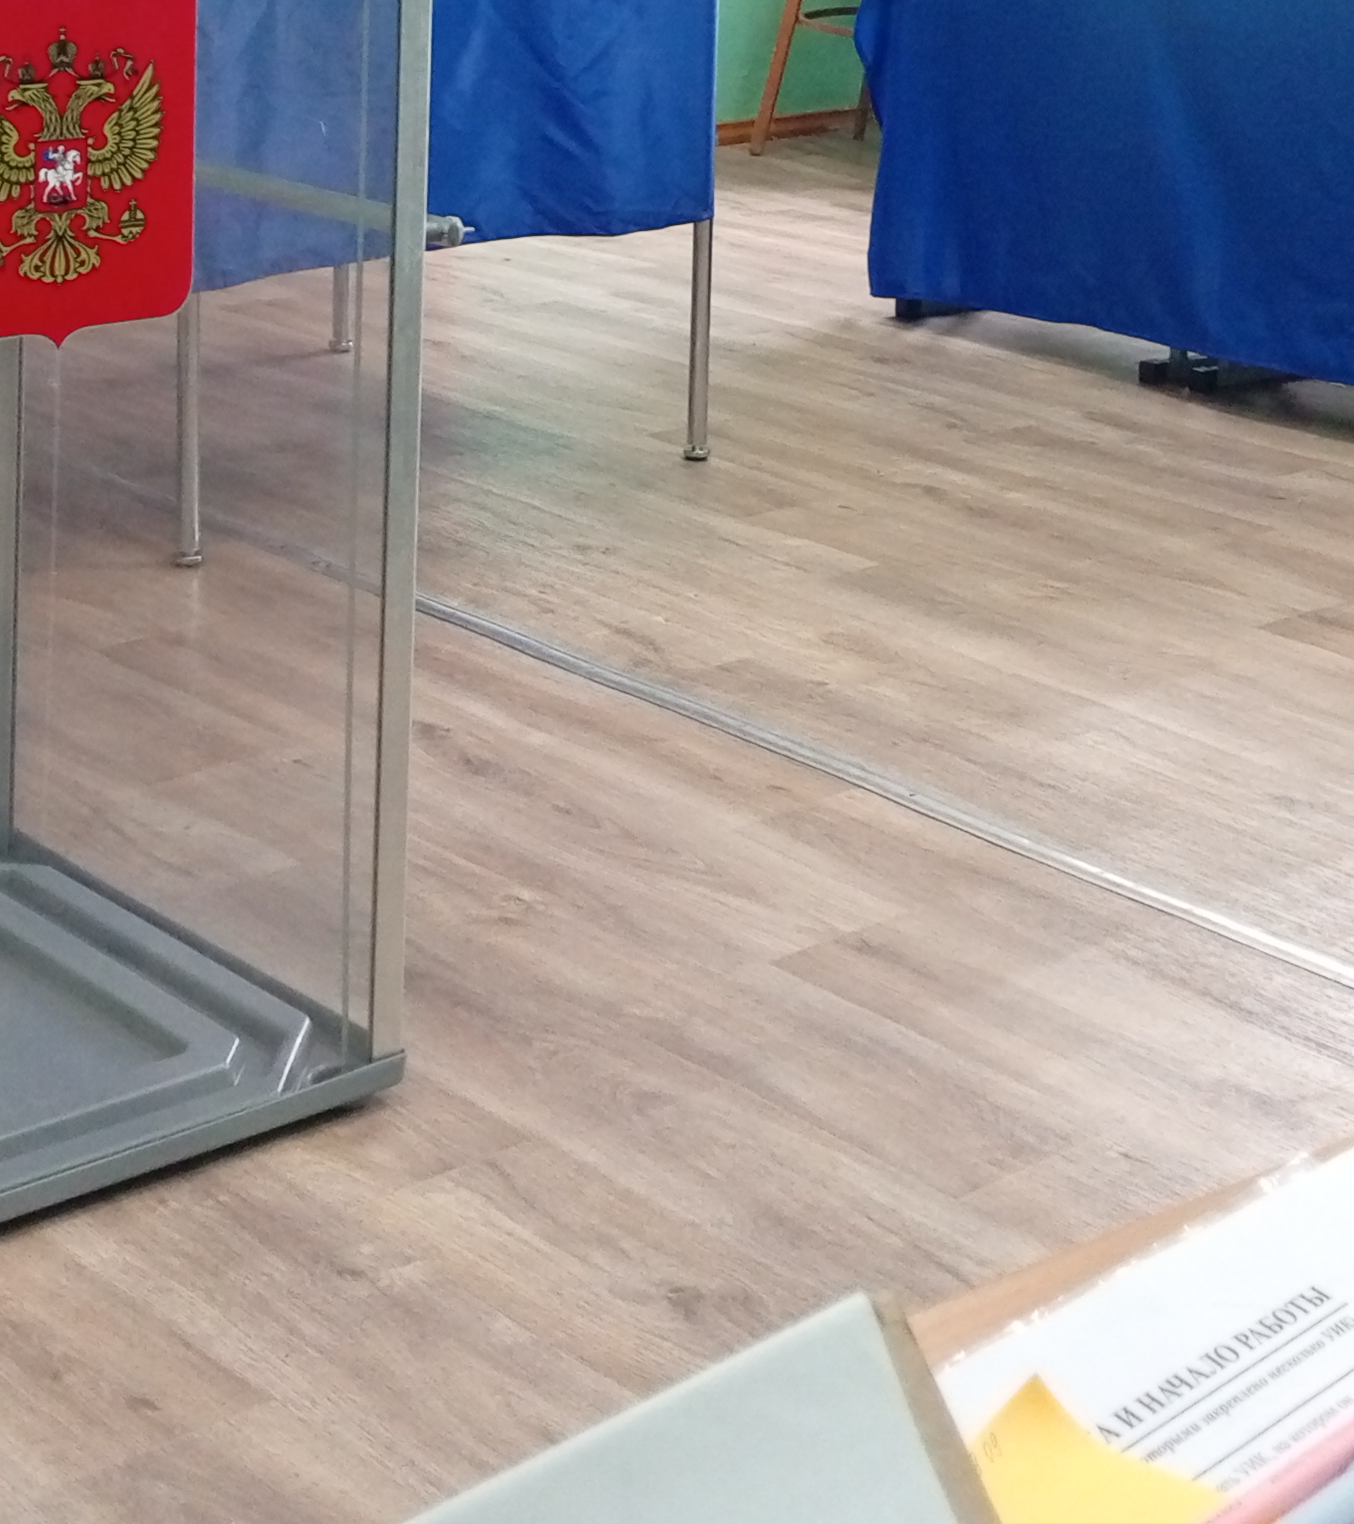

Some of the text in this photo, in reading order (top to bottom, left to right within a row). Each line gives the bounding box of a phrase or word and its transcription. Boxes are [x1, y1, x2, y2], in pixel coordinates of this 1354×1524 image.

[1113, 1407, 1144, 1429] И
[1136, 1345, 1240, 1414] НАЧАЛО
[1233, 1286, 1331, 1350] РАБОТЫ
